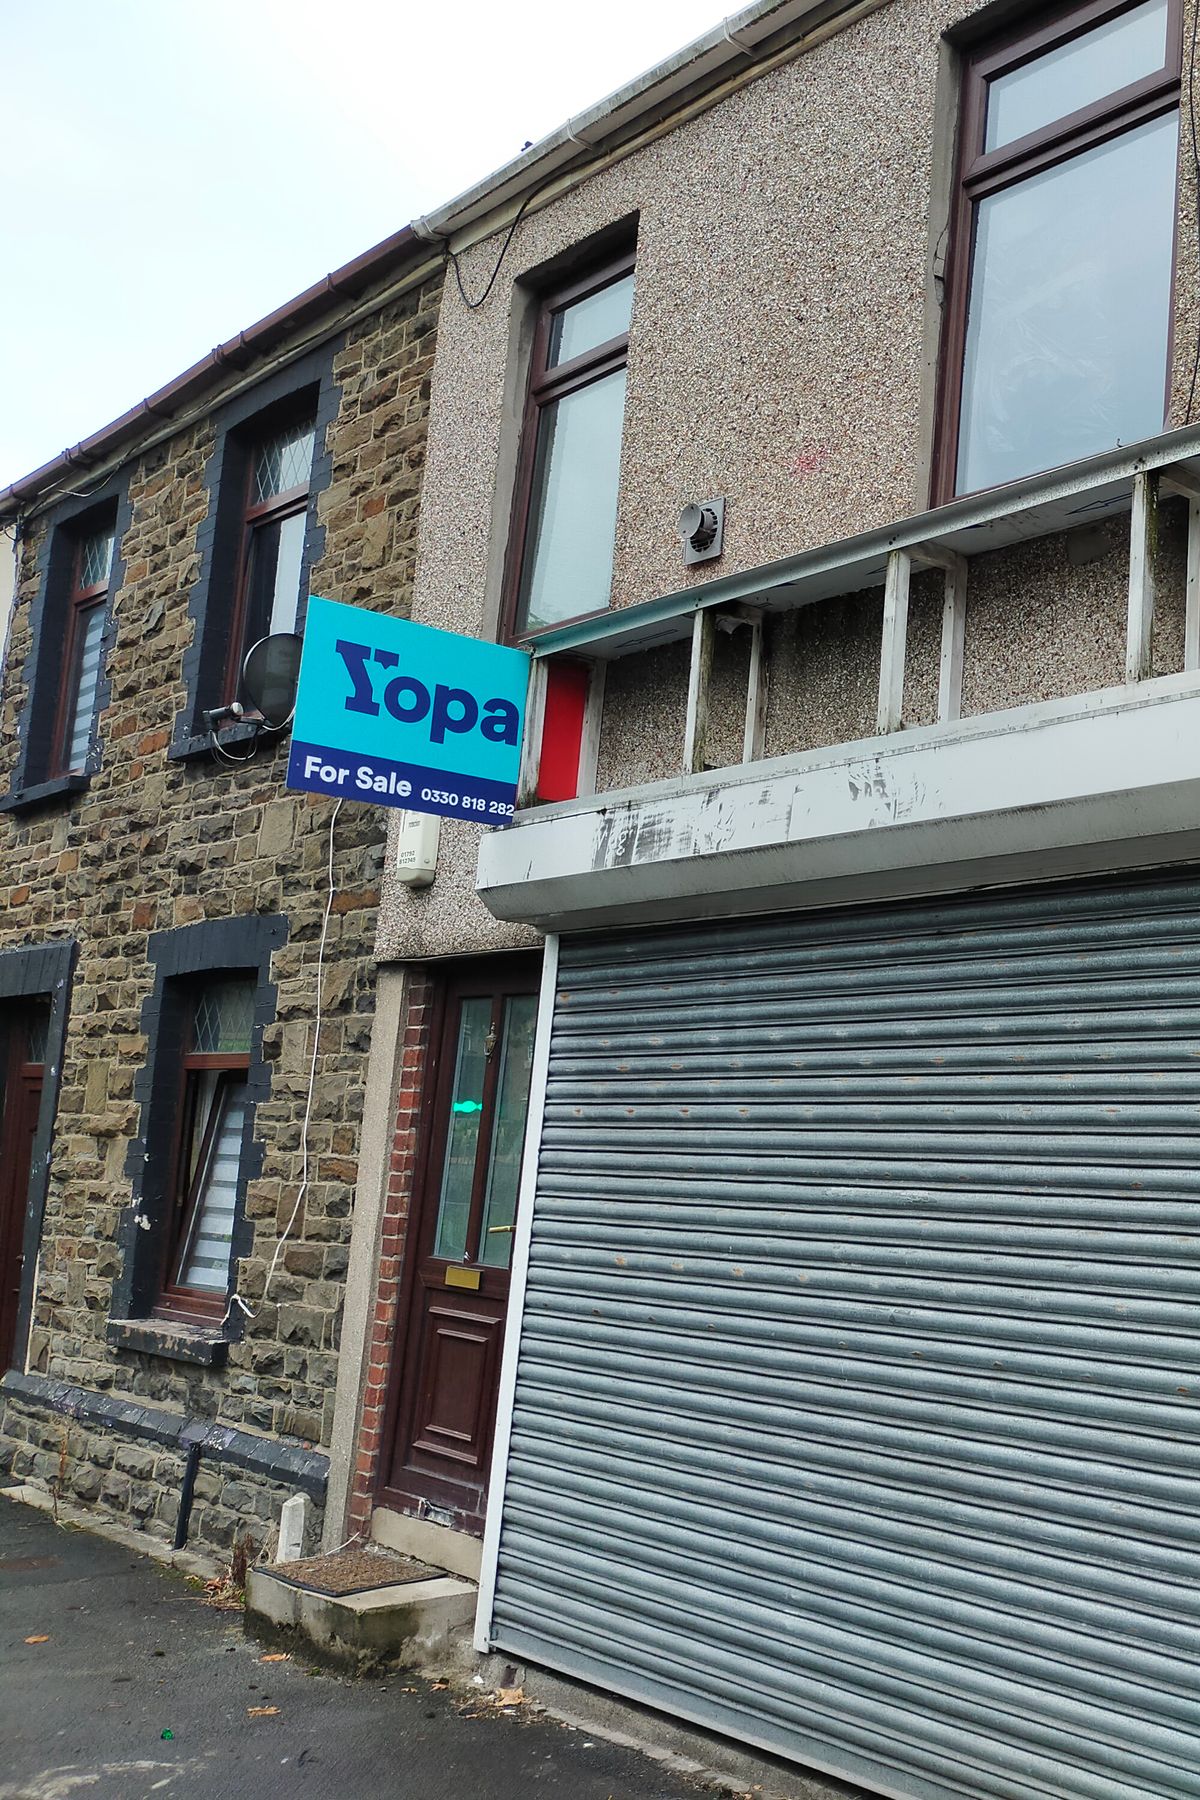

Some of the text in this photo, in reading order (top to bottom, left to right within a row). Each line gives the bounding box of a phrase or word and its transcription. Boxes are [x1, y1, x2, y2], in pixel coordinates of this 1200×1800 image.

[335, 639, 519, 746] Yopa
[304, 755, 412, 797] For Sale
[421, 788, 458, 806] 0330
[462, 796, 485, 811] 818
